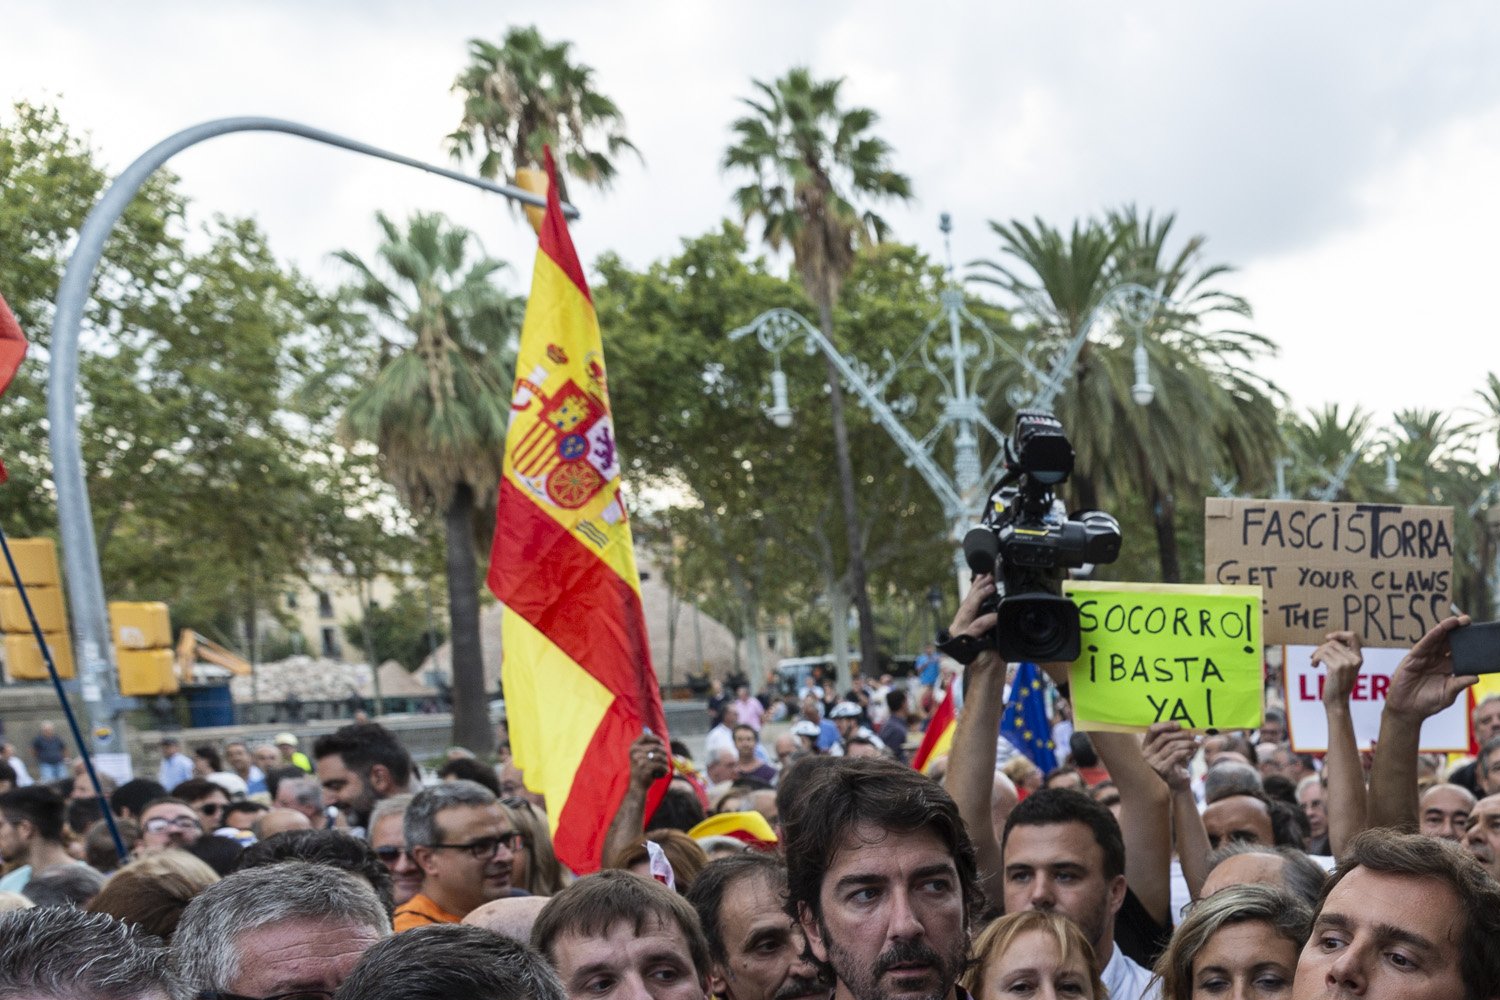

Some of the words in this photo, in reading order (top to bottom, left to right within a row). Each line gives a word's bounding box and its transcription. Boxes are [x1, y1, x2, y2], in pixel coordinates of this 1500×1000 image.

[1216, 560, 1277, 588] GET
[1298, 566, 1359, 589] YOUR
[1371, 570, 1450, 593] CLAWS
[1065, 591, 1255, 653] SOCORRO!
[1279, 602, 1329, 629] THE
[1299, 674, 1391, 701] LIER
[1146, 687, 1219, 735] YA!
